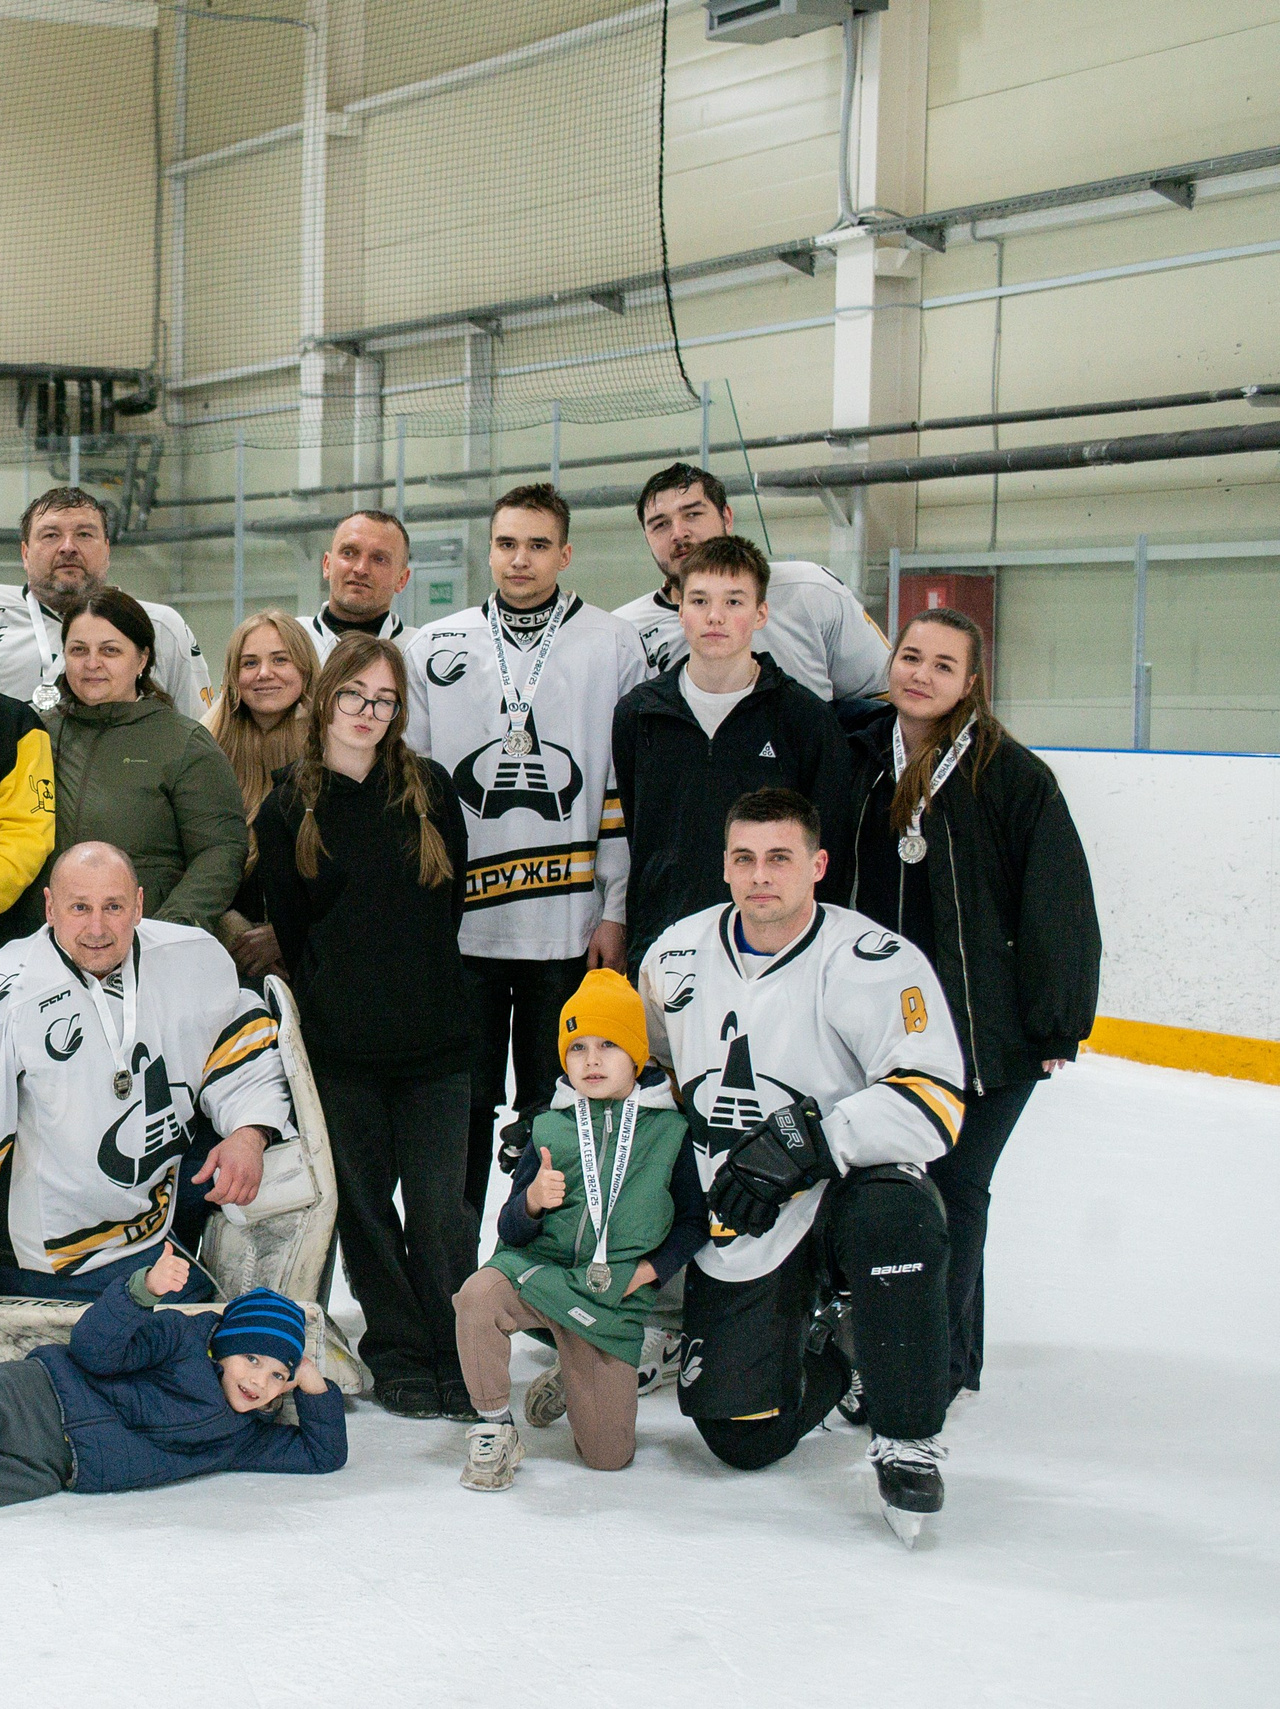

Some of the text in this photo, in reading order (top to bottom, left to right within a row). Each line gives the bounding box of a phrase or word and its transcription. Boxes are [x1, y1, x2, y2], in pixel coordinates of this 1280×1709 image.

[503, 609, 551, 625] CCM
[547, 624, 557, 639] ЛИГА
[494, 637, 510, 686] РЕГИОНАЛЬНЫЙ
[538, 639, 552, 659] СЕЗОН
[901, 986, 928, 1035] 8
[621, 1099, 635, 1143] ЧЕМПИОНАТ
[577, 1098, 599, 1206] НОЧНАЯ ЛИГА СЕЗОН 2024/25
